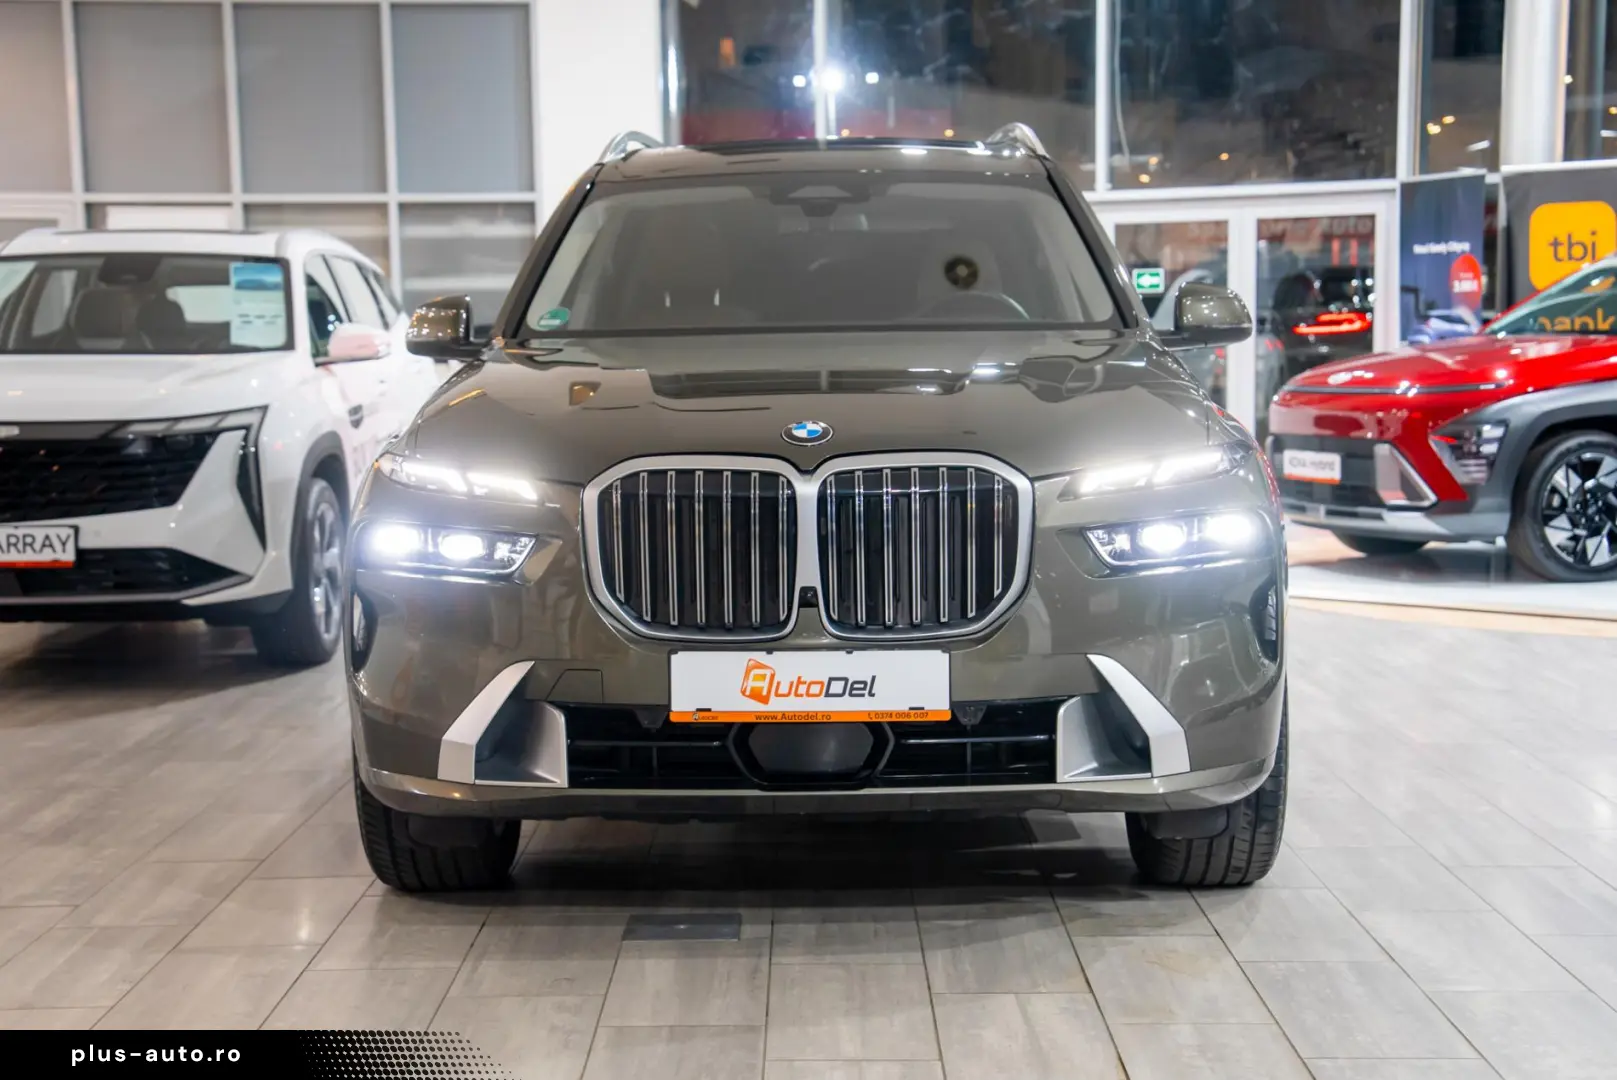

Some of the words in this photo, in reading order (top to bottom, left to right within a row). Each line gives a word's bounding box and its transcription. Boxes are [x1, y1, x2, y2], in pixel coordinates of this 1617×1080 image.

[1549, 230, 1597, 263] tbi
[743, 665, 877, 698] AutoDel
[755, 712, 832, 721] www.Autodel.ro
[874, 712, 893, 720] 0374
